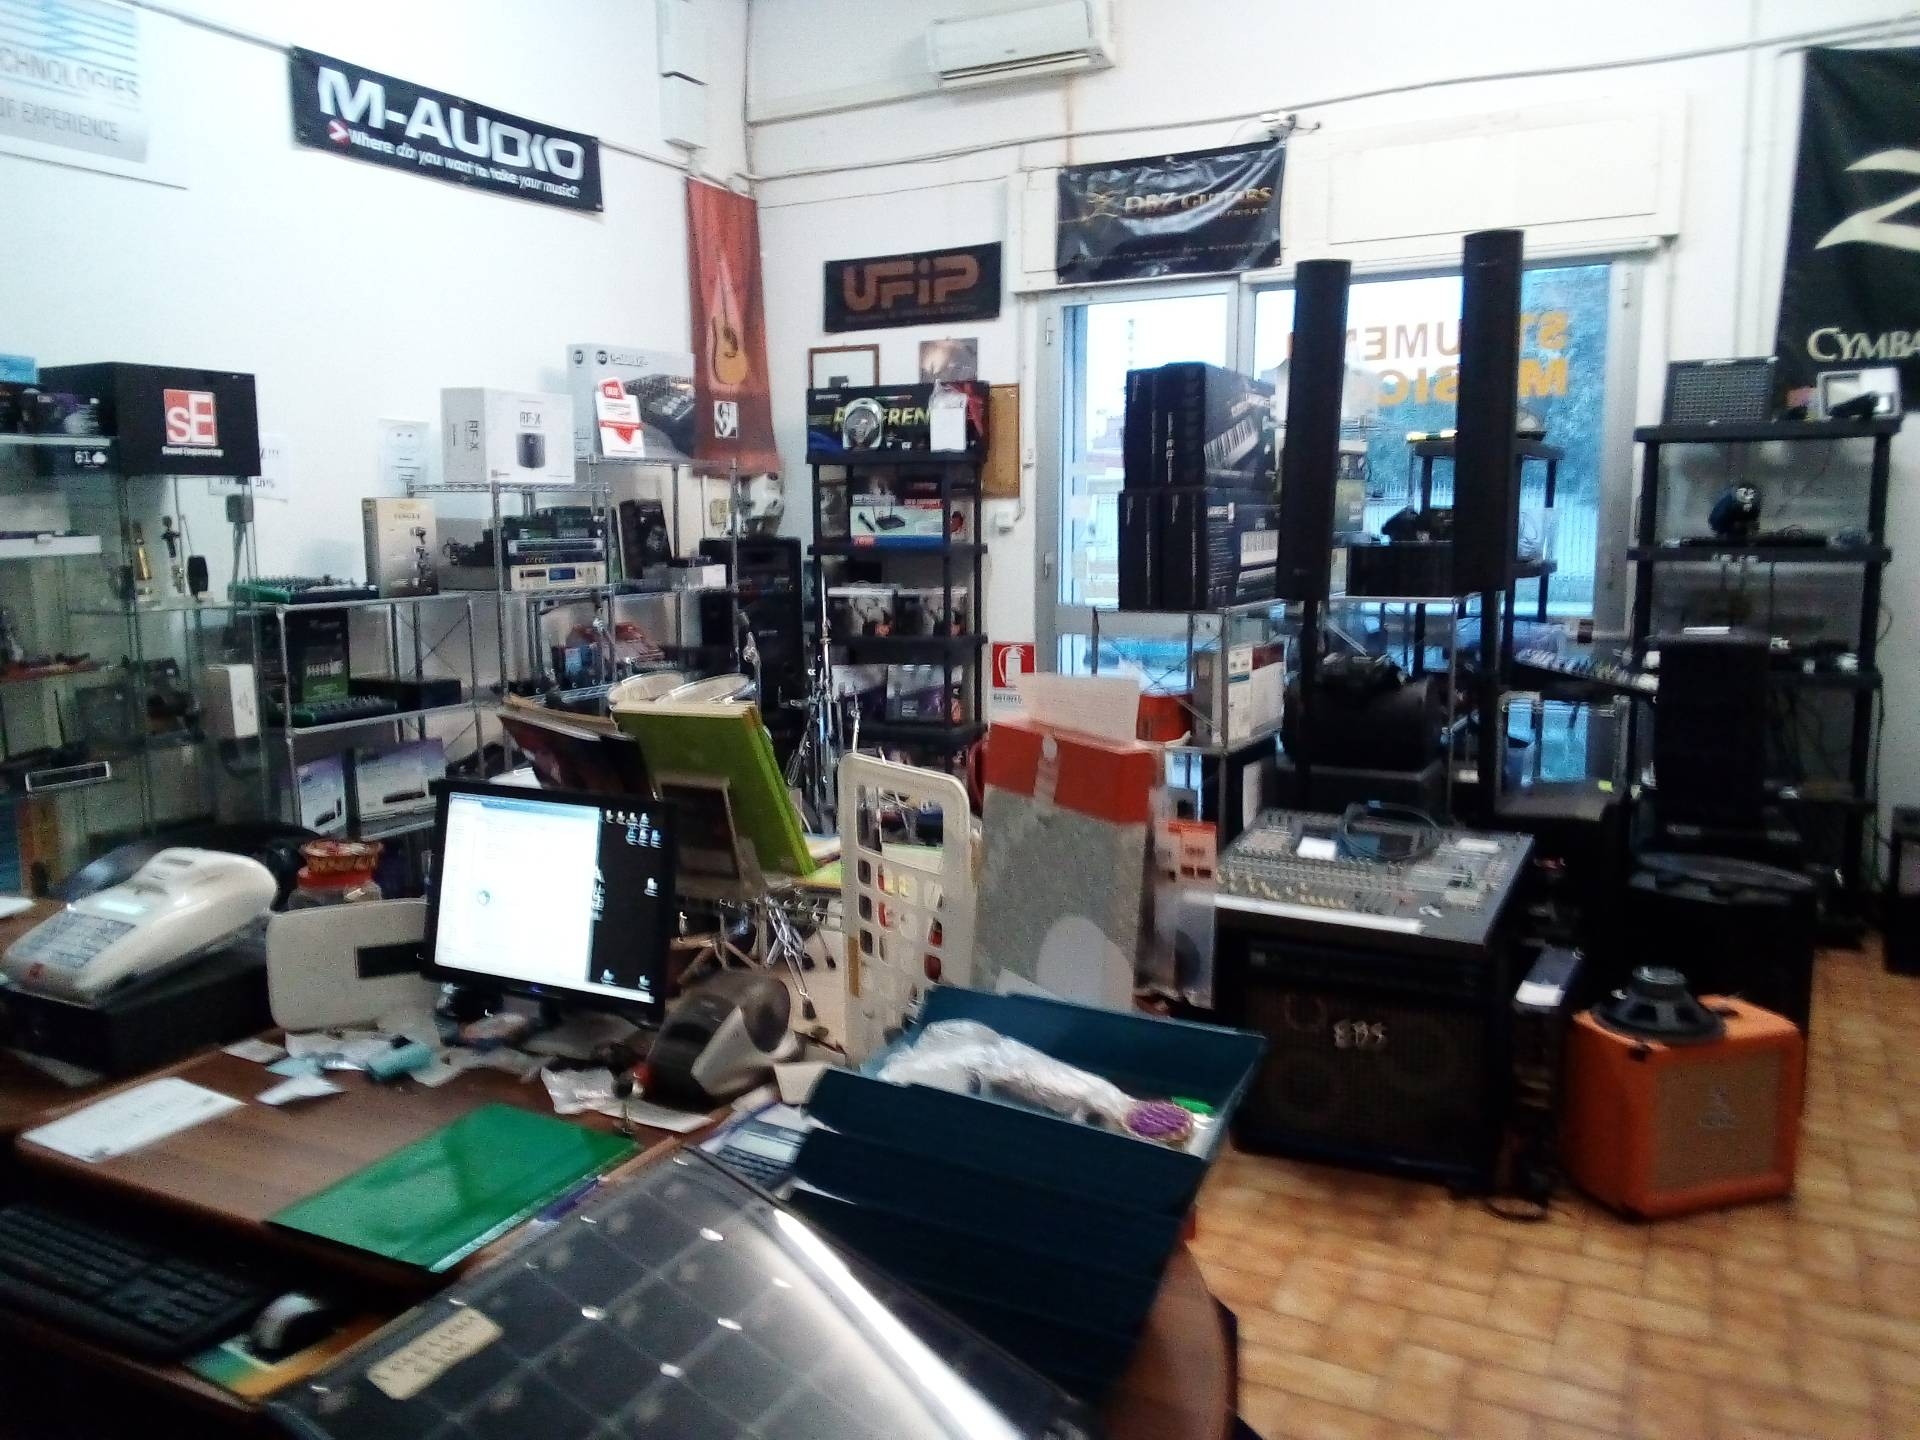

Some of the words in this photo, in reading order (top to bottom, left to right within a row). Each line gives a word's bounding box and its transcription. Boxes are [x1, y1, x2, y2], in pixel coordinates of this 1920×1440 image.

[317, 66, 584, 181] M-AUDIO
[418, 150, 444, 166] you
[519, 175, 543, 190] your
